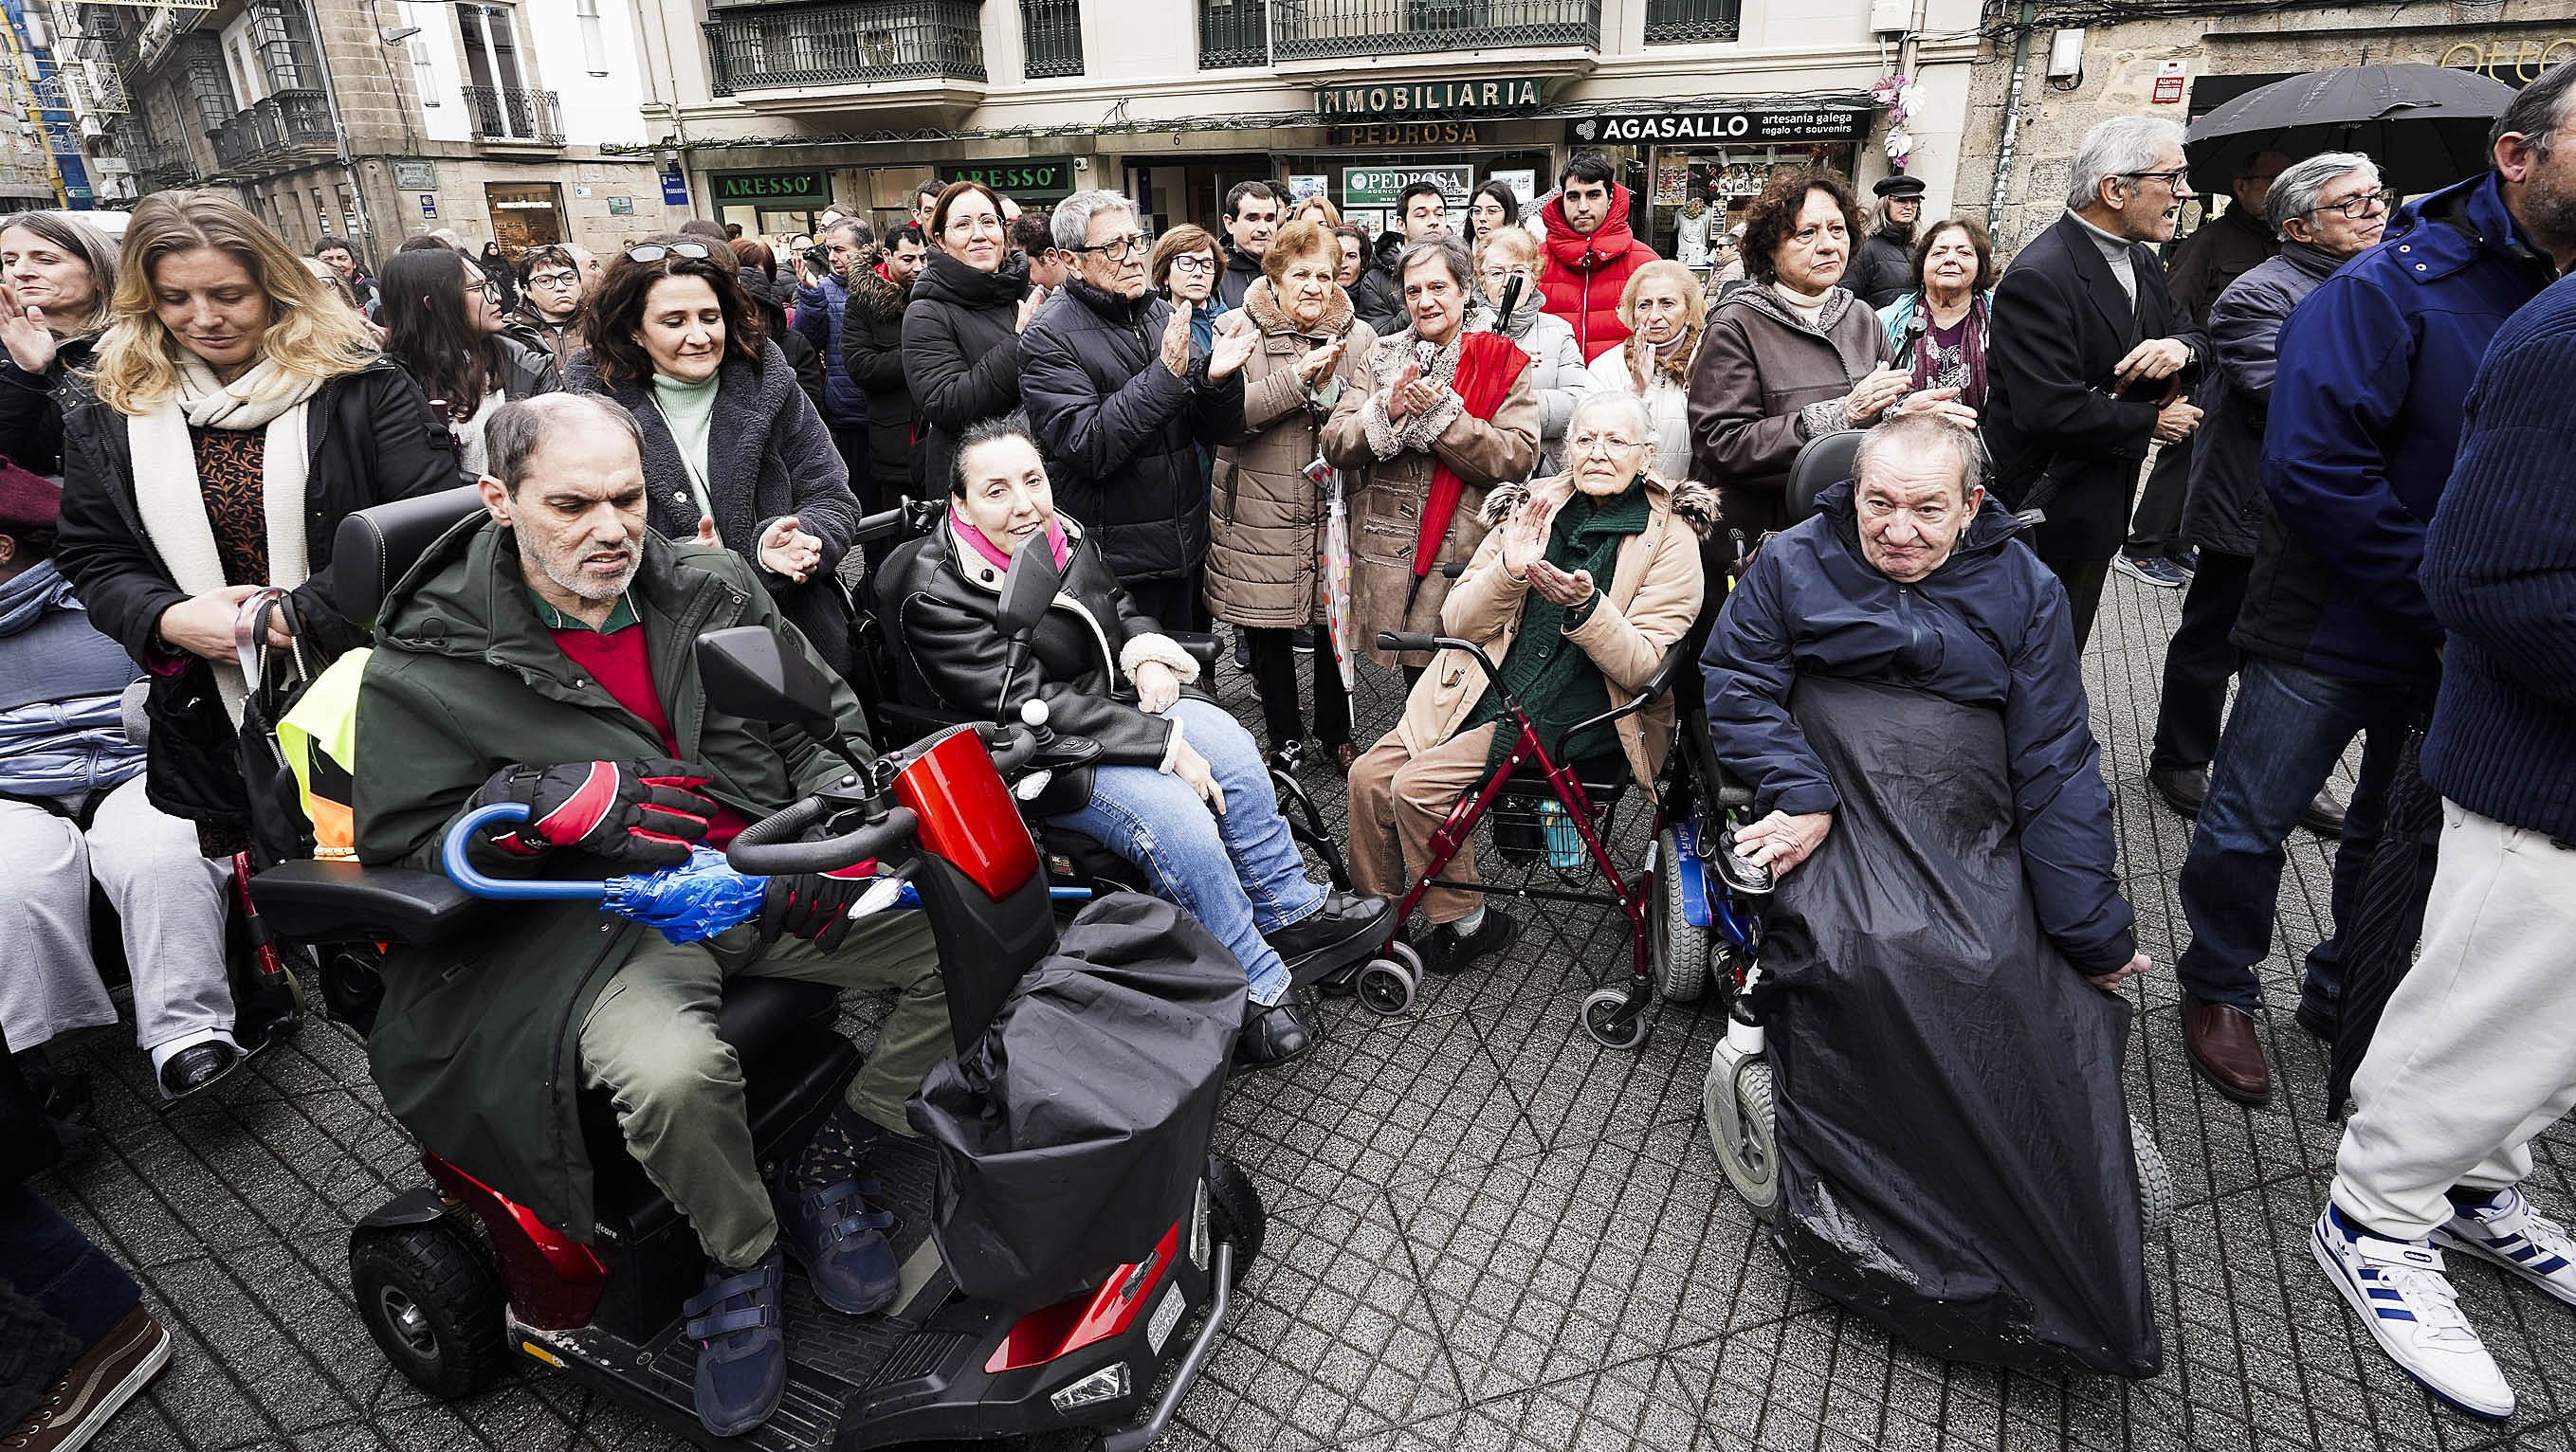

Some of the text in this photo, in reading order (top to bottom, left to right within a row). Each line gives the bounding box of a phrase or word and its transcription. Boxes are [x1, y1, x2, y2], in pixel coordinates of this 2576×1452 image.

[1313, 82, 1537, 114] INMOBILIARIA
[1602, 115, 1749, 139] AGASALLO
[1762, 112, 1852, 125] artesanía galega
[1173, 133, 1180, 146] 6
[1349, 122, 1477, 146] PEDROSA
[1762, 124, 1852, 136] regalo souvenirs
[725, 176, 808, 197] ARESSO
[1367, 171, 1461, 190] PEDROSA
[1147, 1288, 1178, 1338] ORTOPEDIA
[1151, 1298, 1183, 1350] PROVINCIAL
